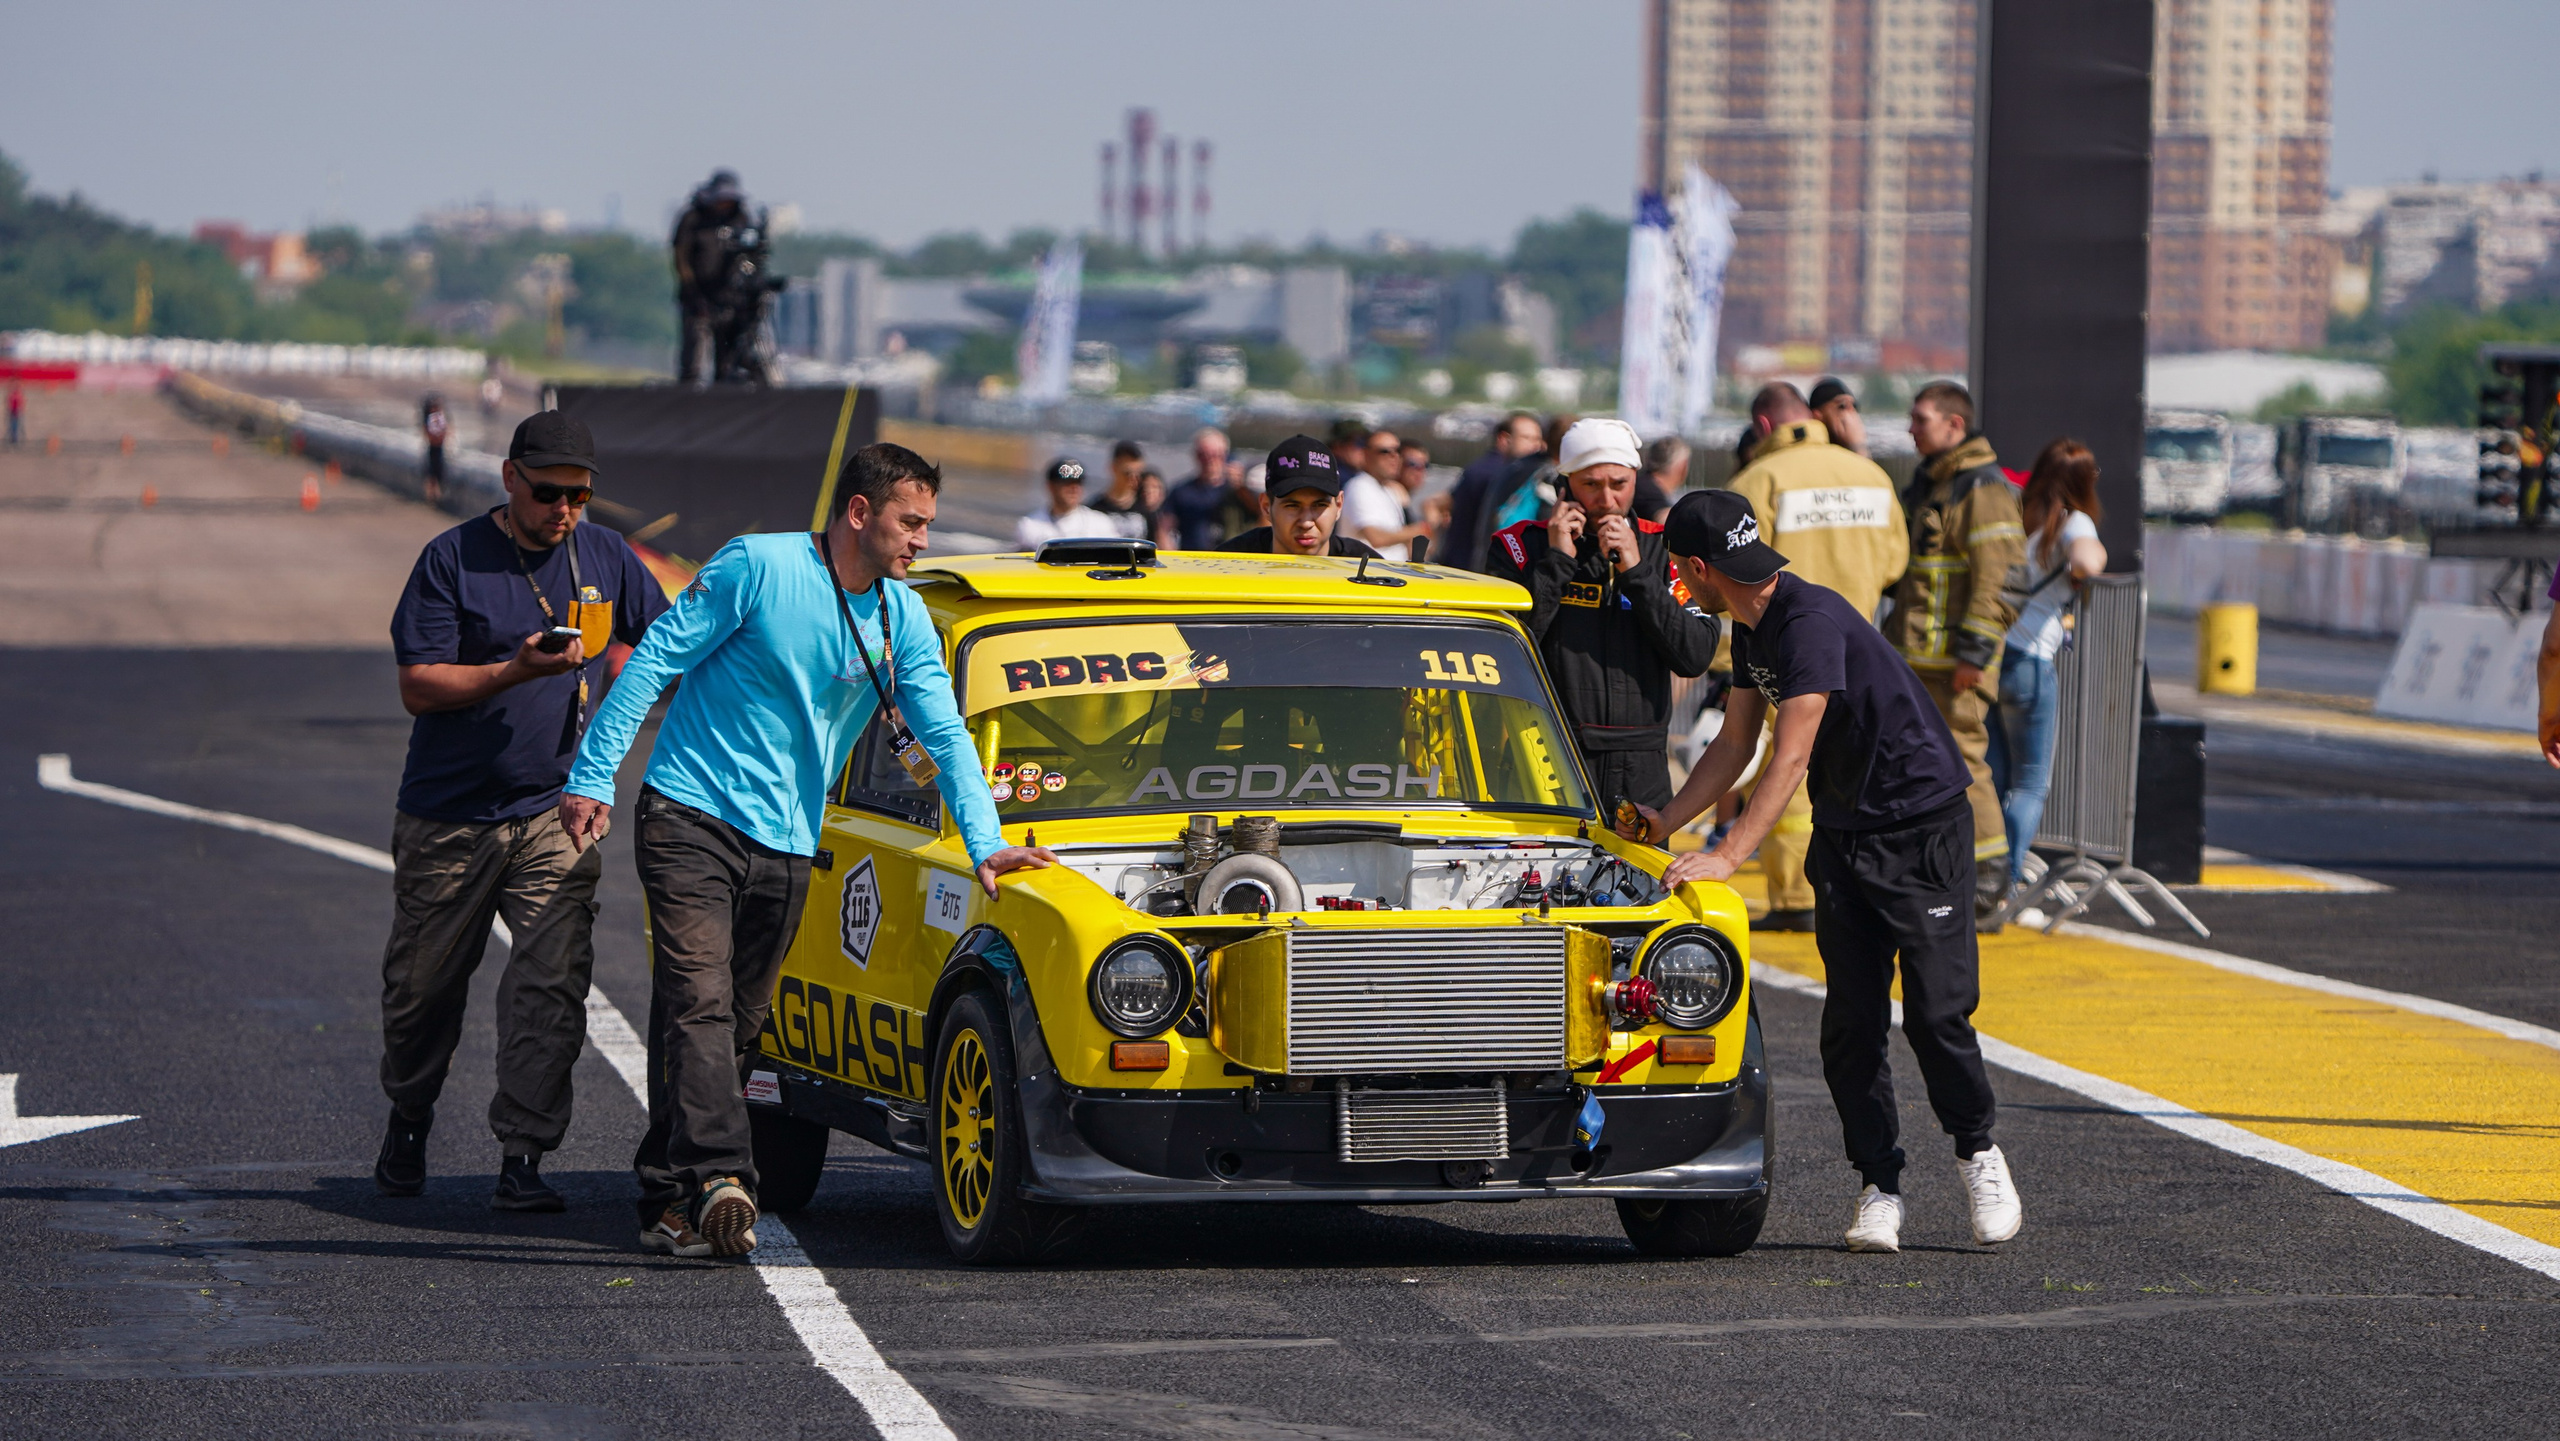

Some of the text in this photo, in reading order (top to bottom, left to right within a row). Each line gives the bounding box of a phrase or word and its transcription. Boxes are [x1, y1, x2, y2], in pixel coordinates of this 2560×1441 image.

[1812, 489, 1857, 504] МЧС
[1796, 508, 1875, 525] РОССИИ
[1001, 652, 1167, 692] RDRC
[1420, 650, 1501, 685] 116
[1127, 764, 1441, 802] AGDASH
[851, 896, 870, 928] 116
[941, 891, 961, 921] ВТБ
